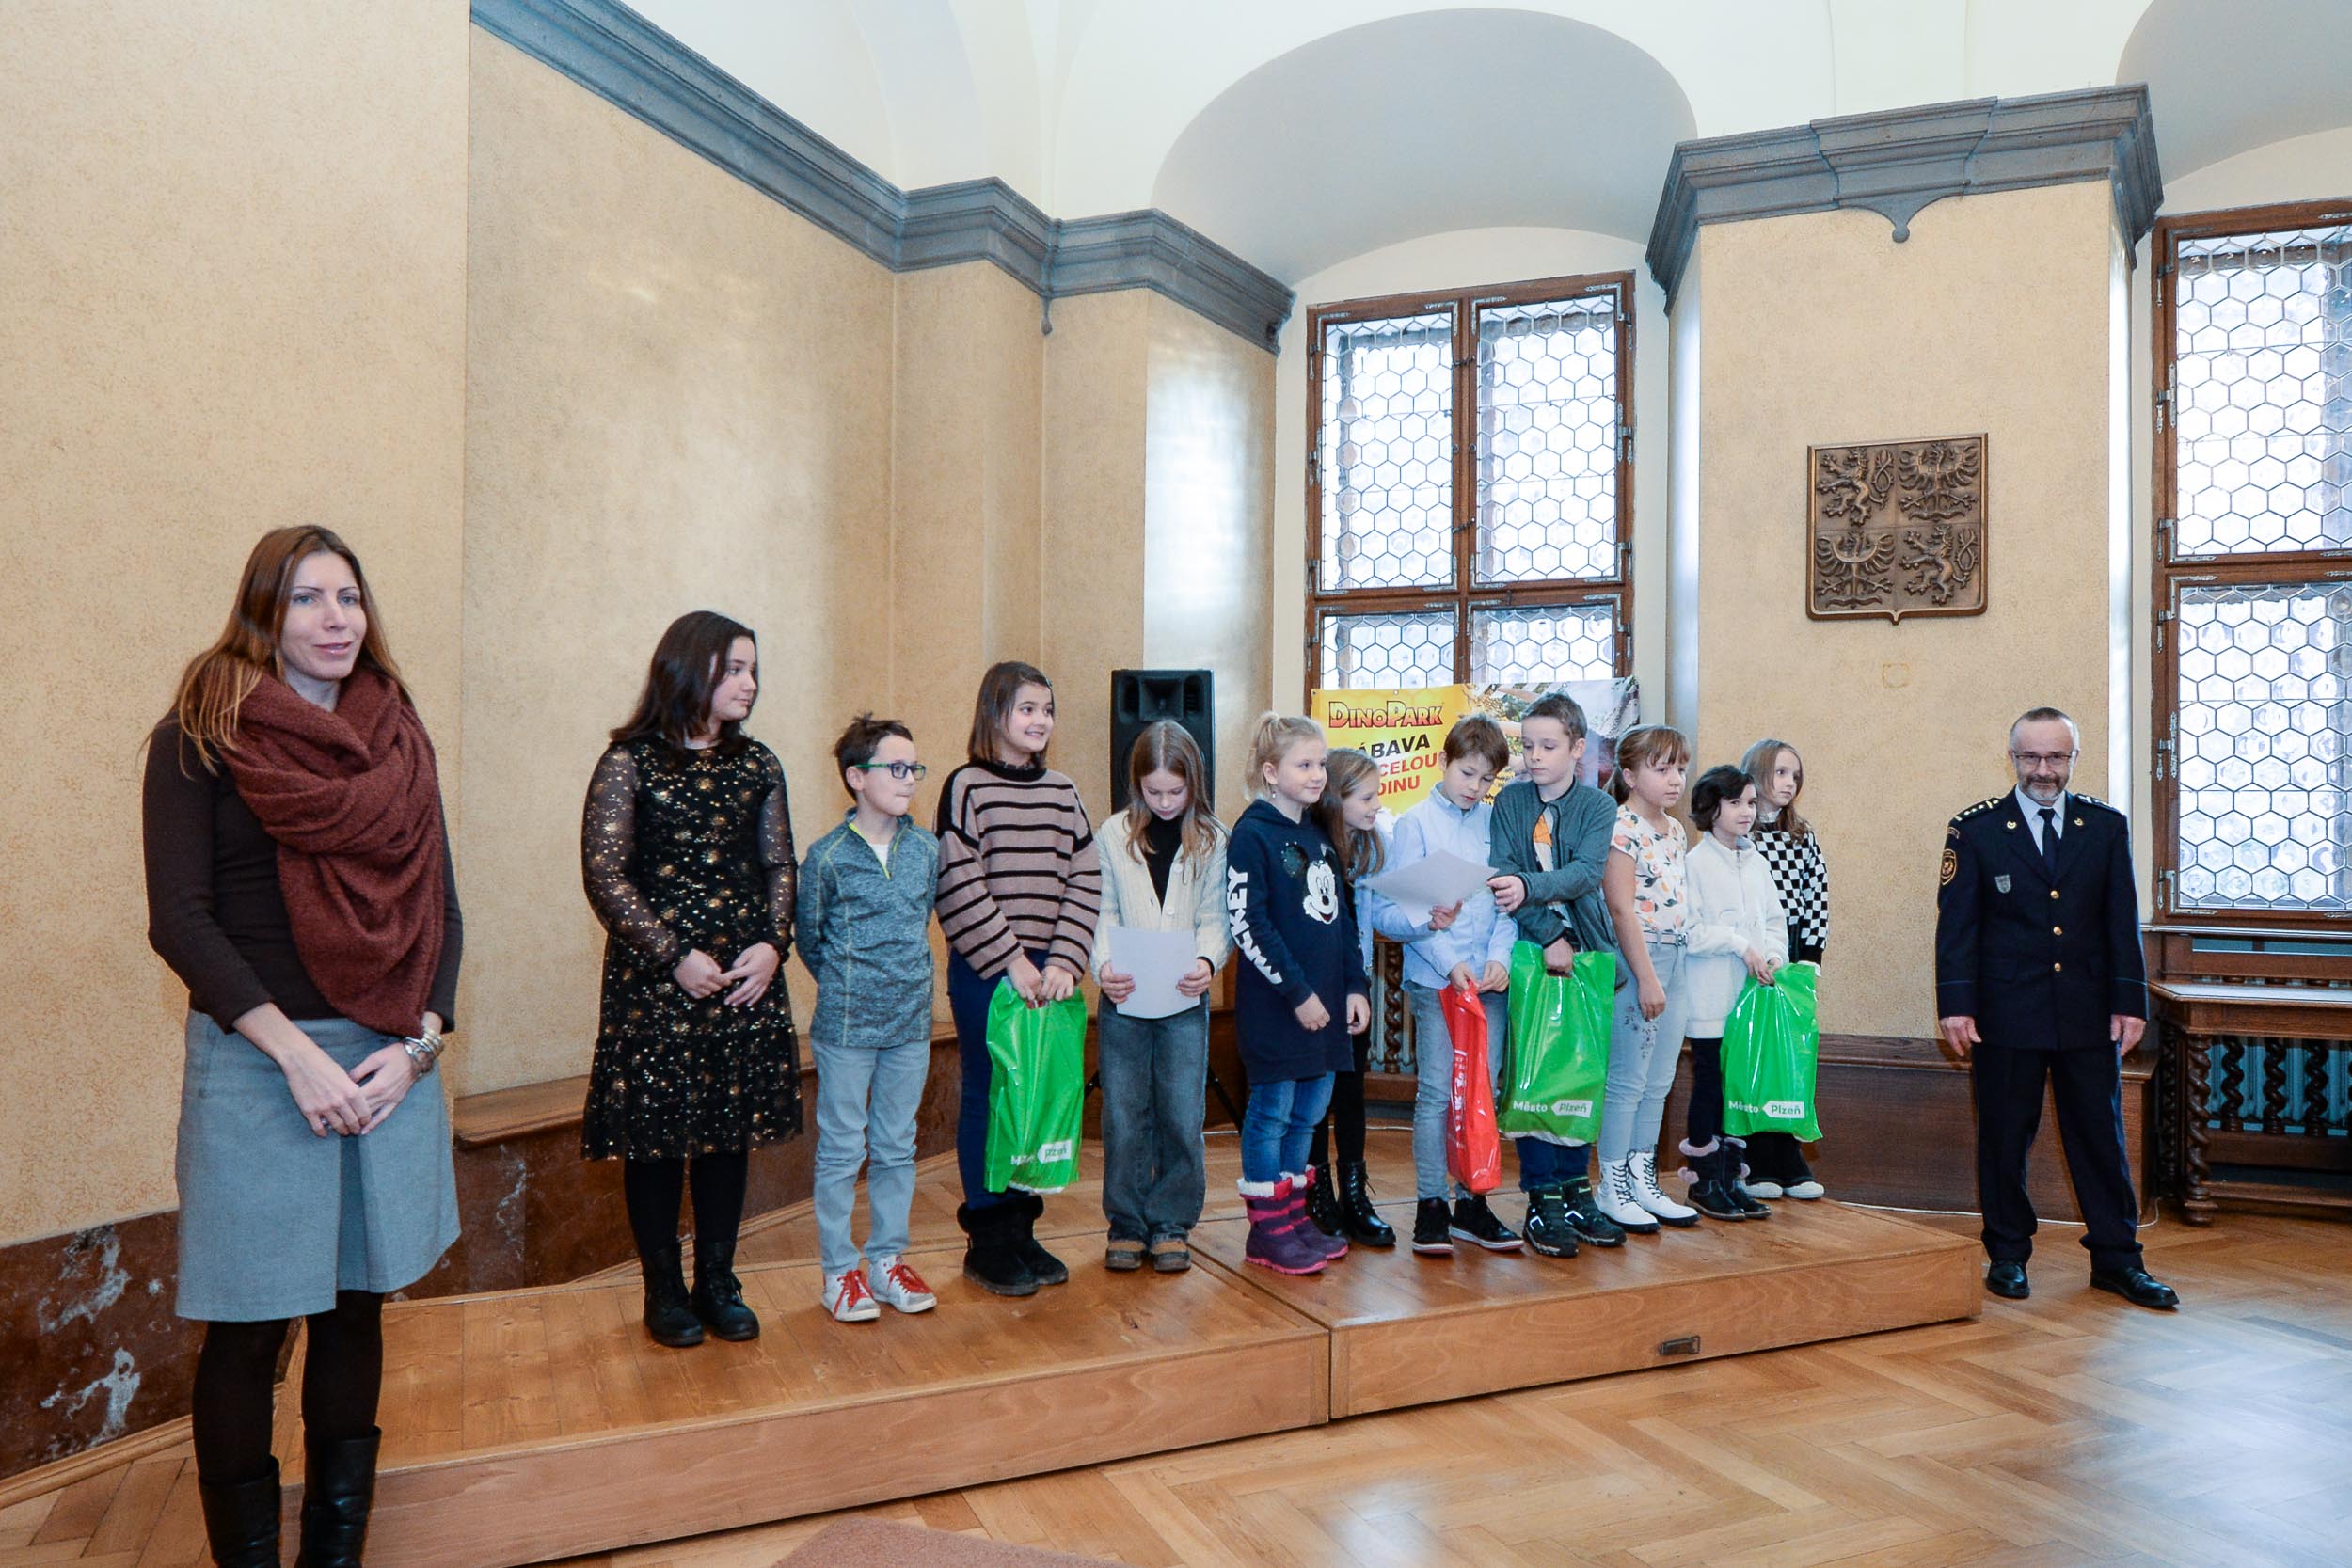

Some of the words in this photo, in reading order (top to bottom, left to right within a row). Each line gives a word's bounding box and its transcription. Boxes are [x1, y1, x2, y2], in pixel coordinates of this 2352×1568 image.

[1359, 733, 1431, 759] ÁBAVA
[1379, 752, 1438, 777] CELOU
[1377, 775, 1421, 797] DINU
[1771, 1104, 1801, 1115] Plzeň
